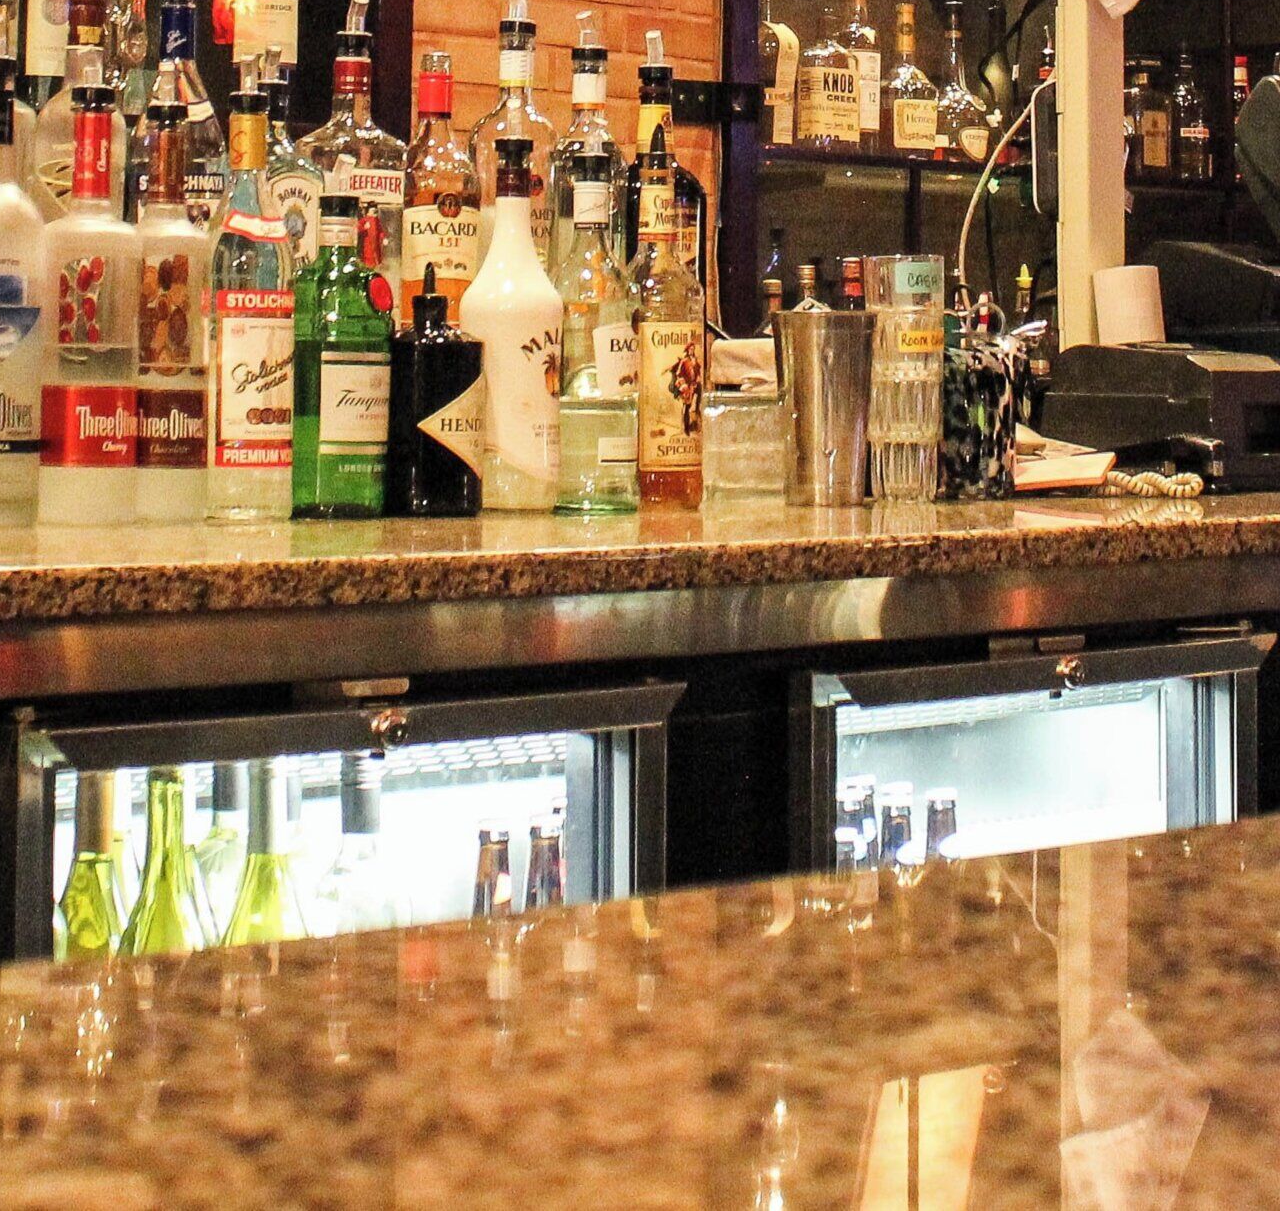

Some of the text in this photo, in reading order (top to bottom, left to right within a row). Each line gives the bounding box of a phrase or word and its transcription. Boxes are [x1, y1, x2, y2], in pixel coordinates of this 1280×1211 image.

[823, 72, 854, 94] KNOB
[826, 94, 858, 104] CREEK
[277, 186, 313, 207] BOMBAY
[438, 238, 460, 248] 151
[651, 330, 688, 348] Captain
[223, 449, 278, 464] PREMIUM
